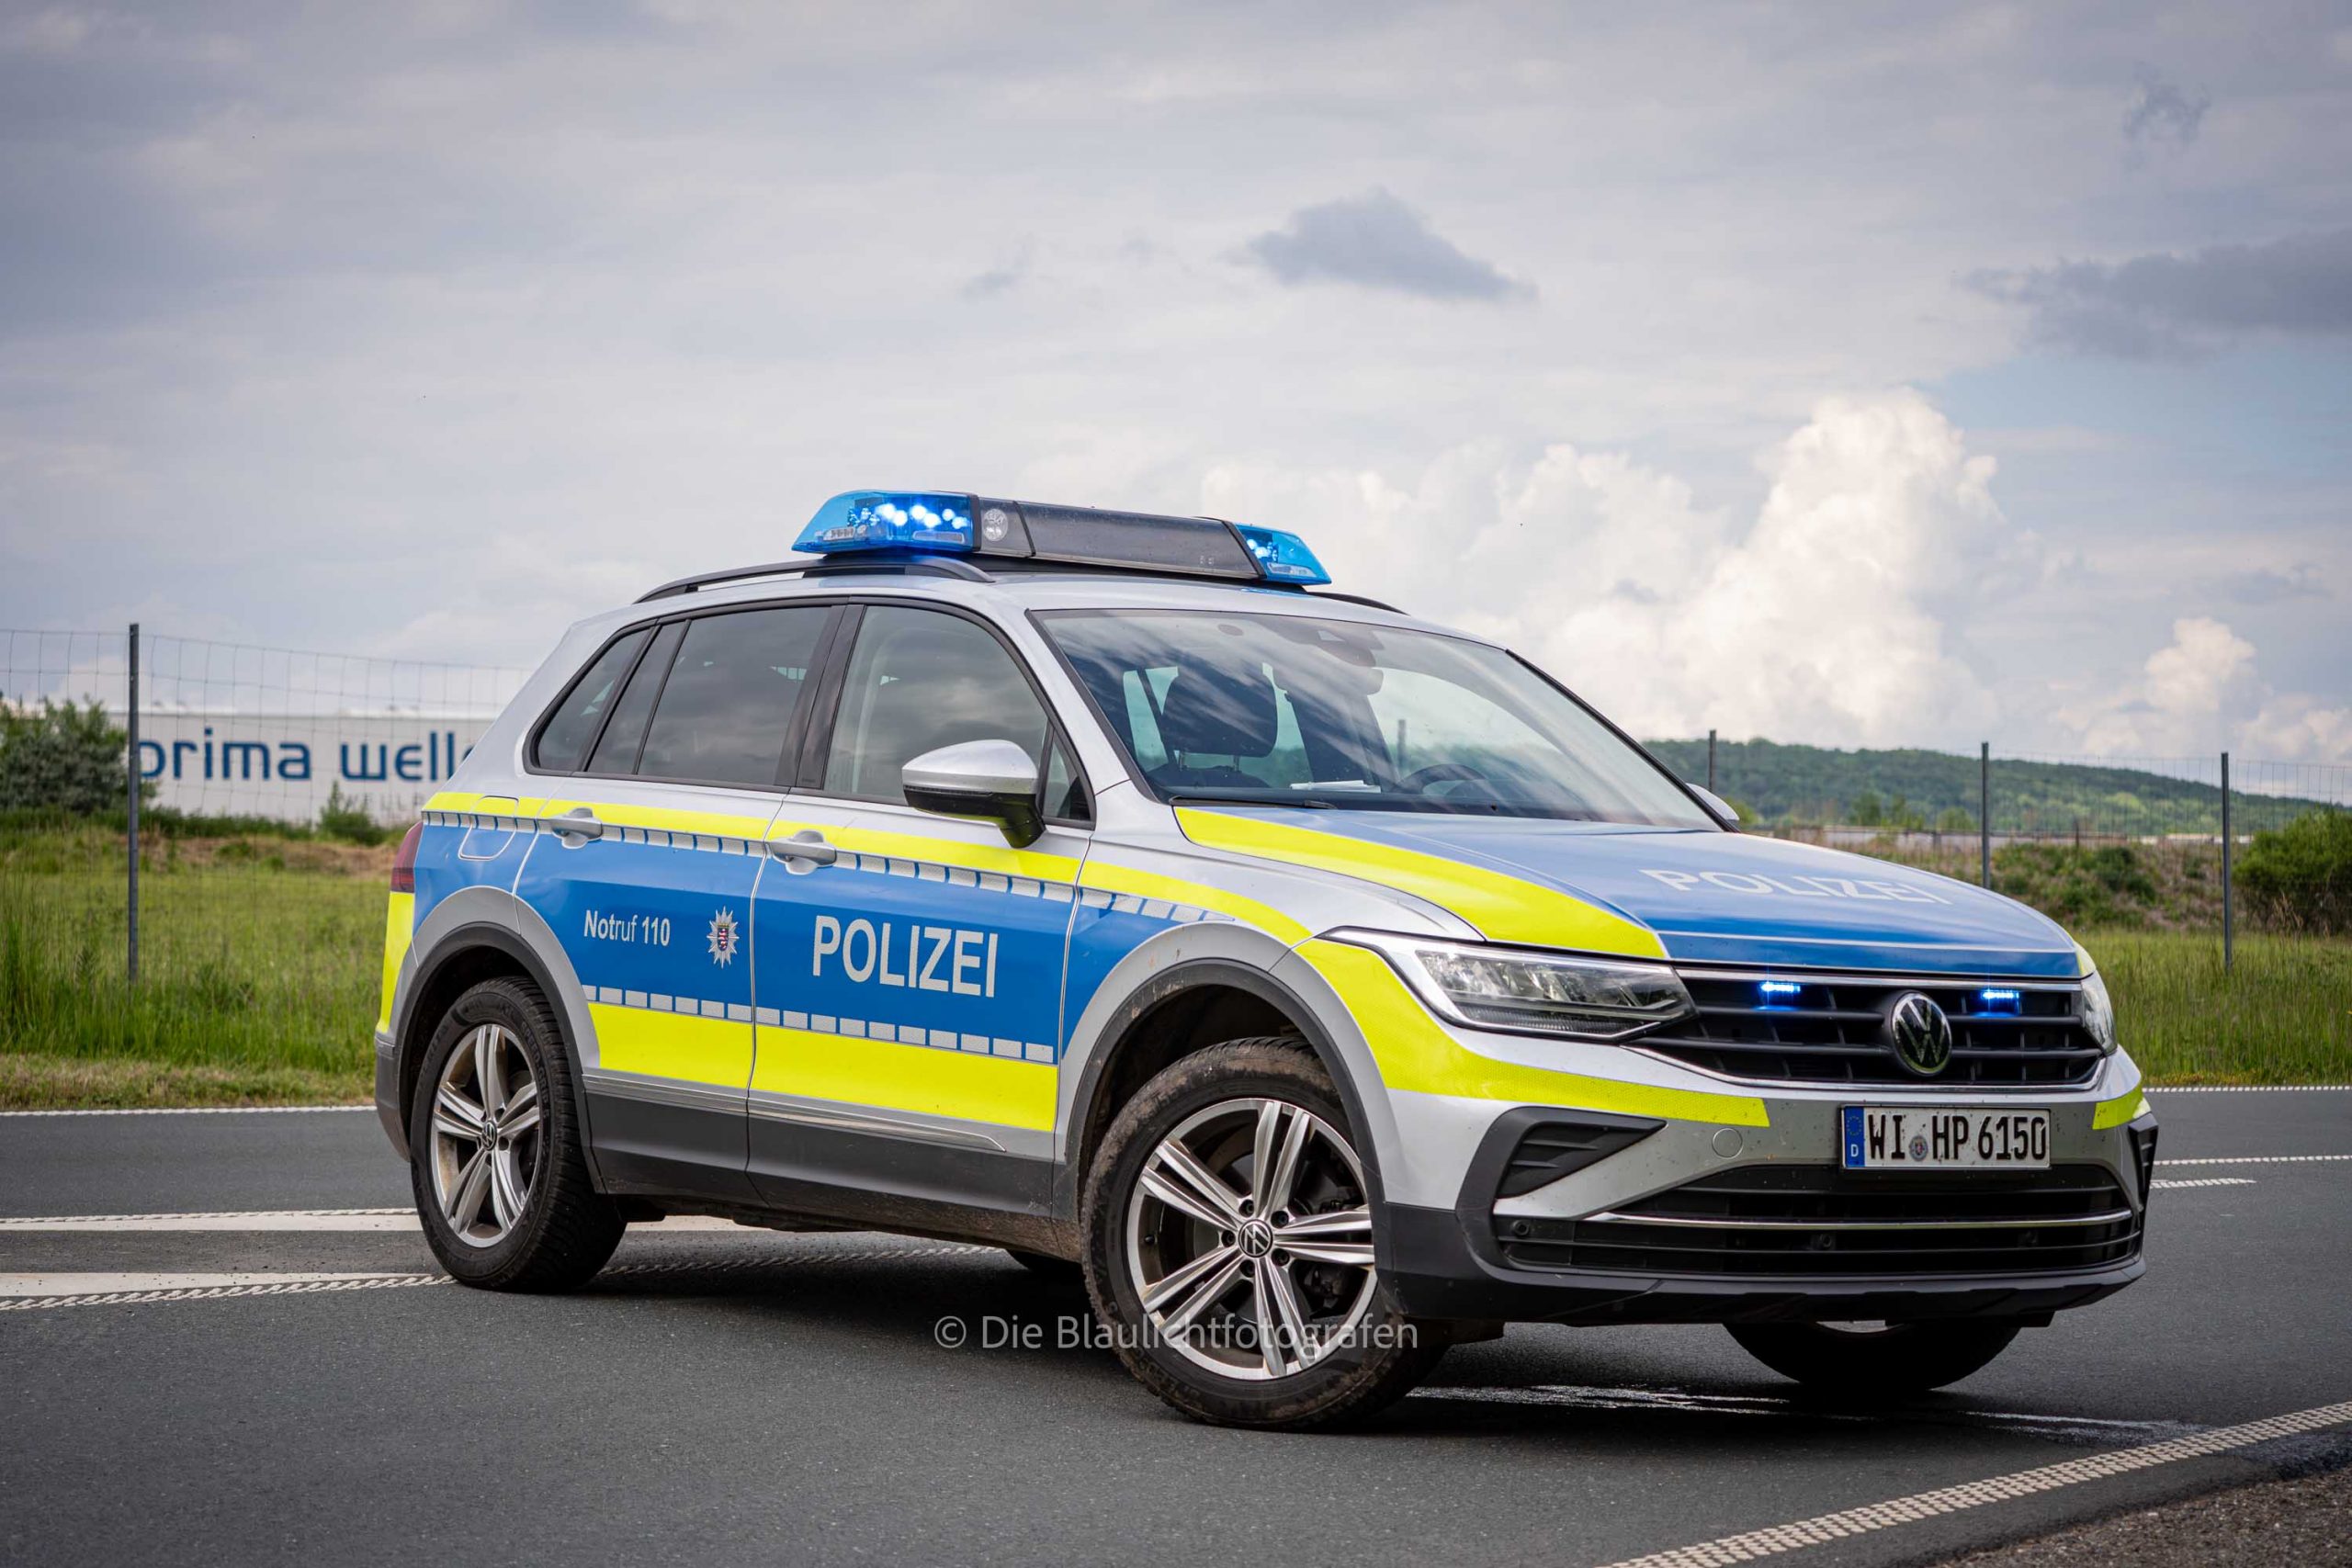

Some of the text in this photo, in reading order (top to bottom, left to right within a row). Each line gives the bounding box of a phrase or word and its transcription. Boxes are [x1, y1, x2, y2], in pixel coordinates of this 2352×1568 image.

[340, 731, 474, 782] well
[1639, 869, 1952, 905] POLIZEI
[583, 909, 670, 946] Notruf 110
[813, 915, 998, 998] POLIZEI
[1850, 1145, 1859, 1157] D
[1868, 1114, 2046, 1160] WI HP 6150
